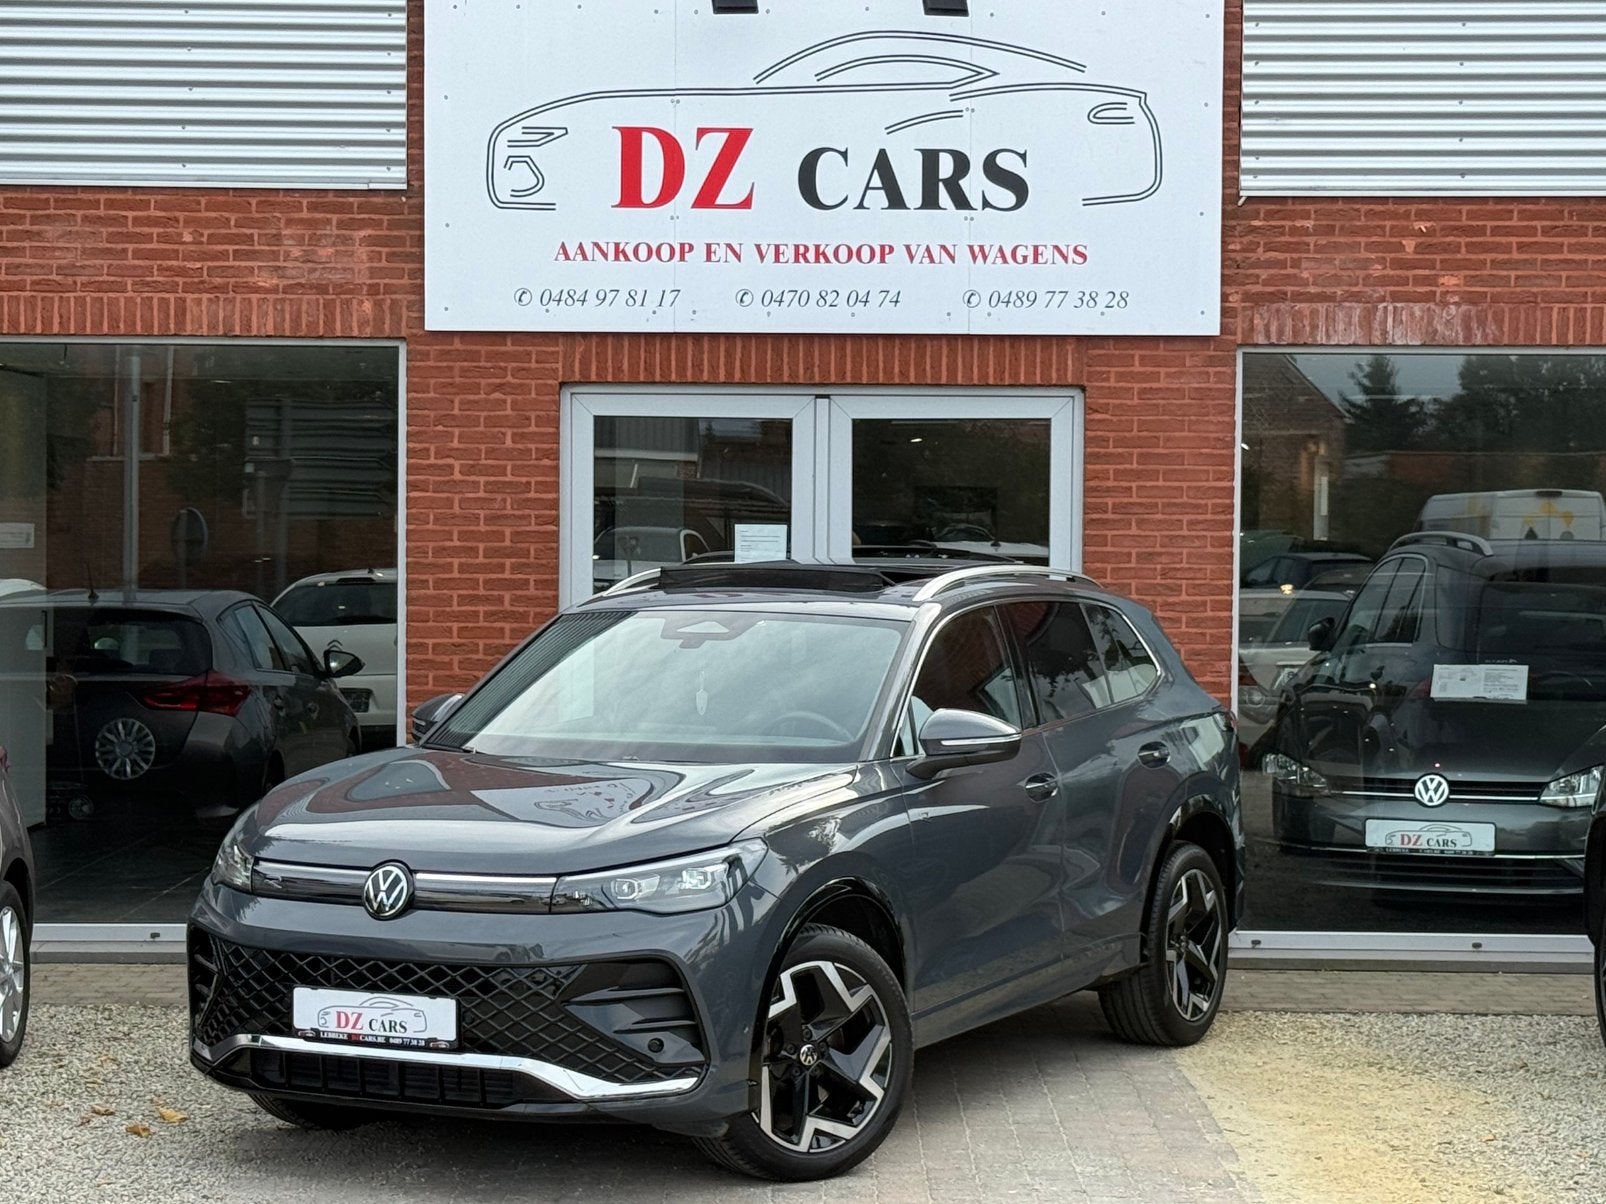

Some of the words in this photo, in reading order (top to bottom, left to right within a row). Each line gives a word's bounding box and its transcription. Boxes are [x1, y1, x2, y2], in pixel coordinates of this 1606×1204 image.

[611, 126, 755, 210] DZ
[797, 147, 1029, 212] CARS
[554, 241, 694, 263] AANKOOP
[703, 242, 743, 263] EN
[754, 243, 895, 264] VERKOOP
[902, 244, 957, 265] VAN
[967, 244, 1088, 265] WAGENS
[539, 288, 589, 308] 0484
[595, 288, 620, 308] 97
[625, 288, 648, 308] 81
[656, 288, 681, 308] 17
[760, 289, 811, 308] 0470
[815, 289, 839, 308] 82
[846, 289, 871, 308] 04
[877, 289, 901, 308] 74
[988, 290, 1037, 309] 0489
[1043, 290, 1068, 309] 77
[1073, 290, 1098, 309] 38
[1104, 290, 1129, 309] 28
[1400, 834, 1422, 846] DZ
[1426, 838, 1457, 848] CARS
[335, 1011, 364, 1031] DZ
[368, 1018, 408, 1034] CARS
